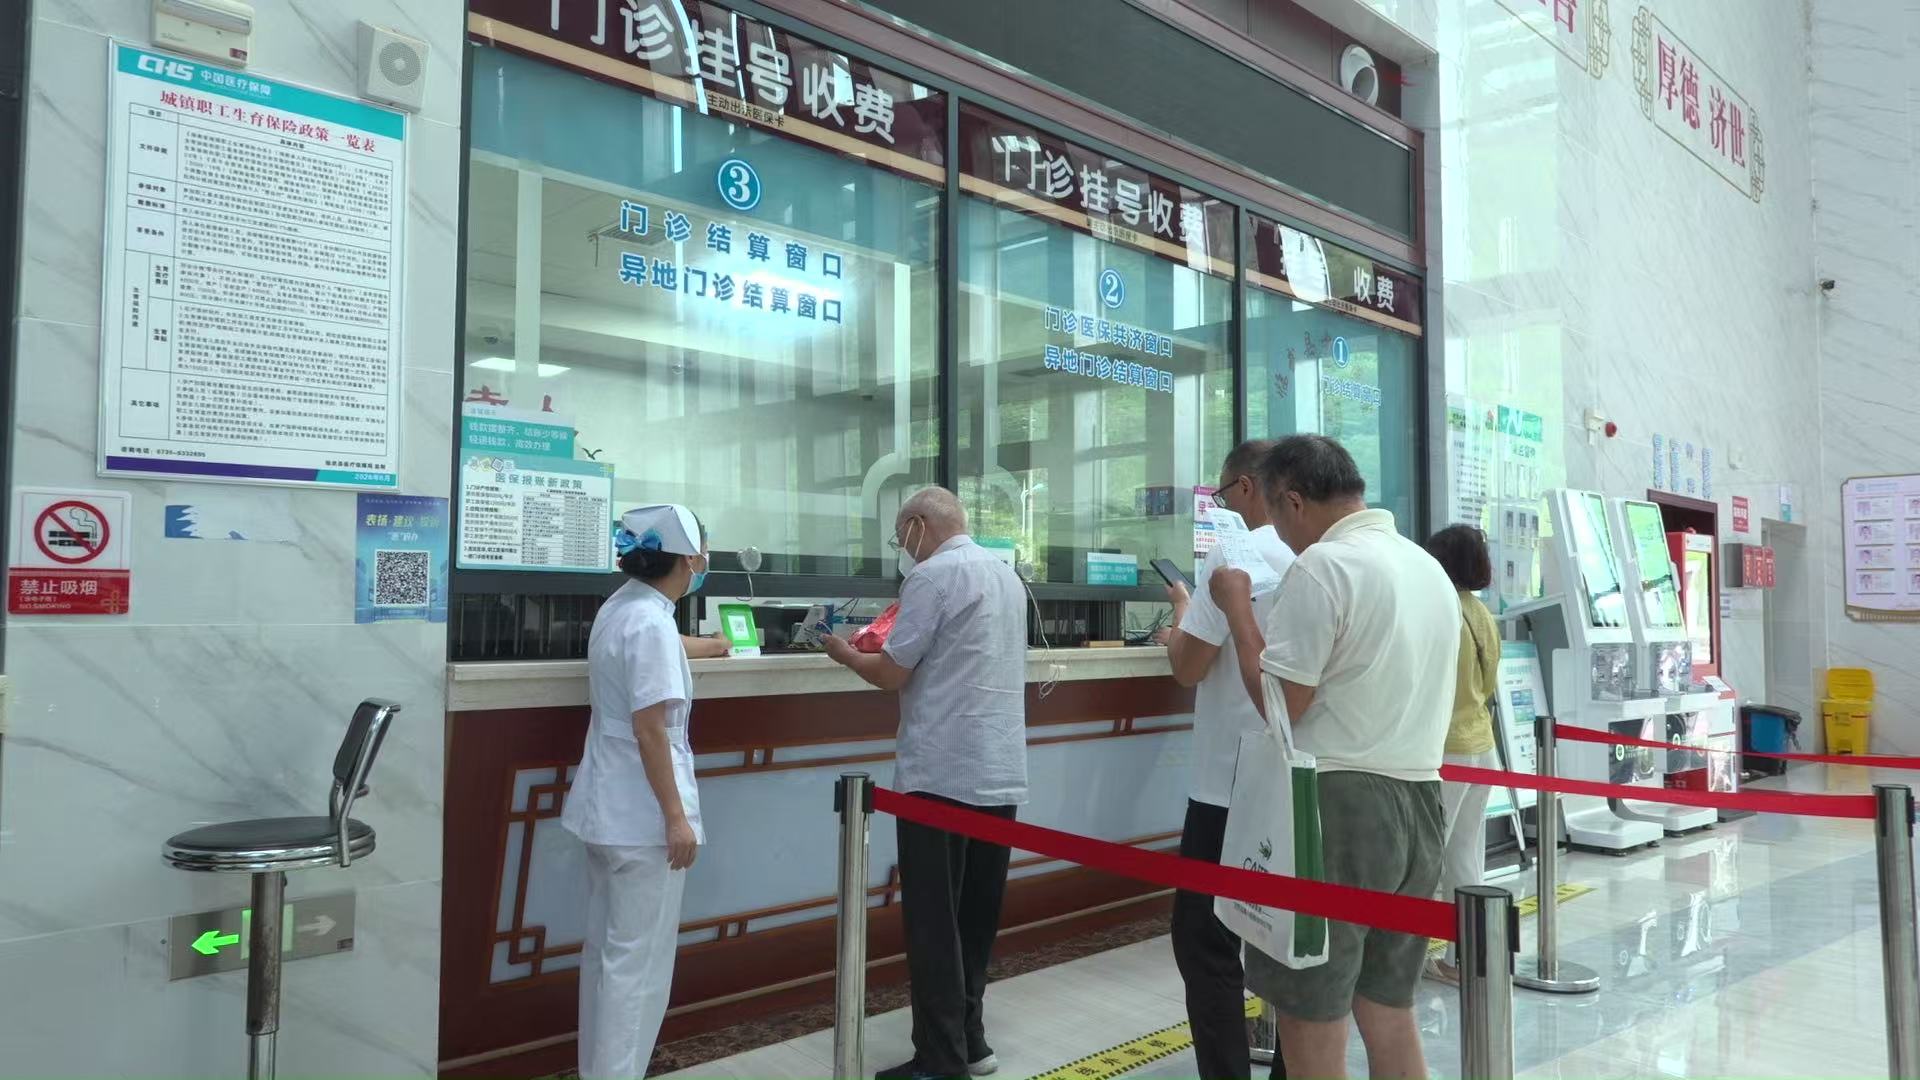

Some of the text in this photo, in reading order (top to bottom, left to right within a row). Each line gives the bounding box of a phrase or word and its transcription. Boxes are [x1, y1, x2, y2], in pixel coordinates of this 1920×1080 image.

[137, 54, 195, 81] CHS
[200, 69, 272, 96] 中国医疗保障
[160, 90, 375, 152] 城镇职工生育保险政策一览表
[1657, 35, 1746, 168] 厚德 济世
[619, 200, 843, 280] 门诊结算窗口
[619, 252, 843, 325] 异地门诊结算窗口
[1043, 305, 1174, 359] 门诊医保共济窗口
[1043, 344, 1174, 394] 异地门诊结算窗口
[495, 472, 584, 490] 医保报账新政策
[20, 579, 98, 595] 禁止吸烟
